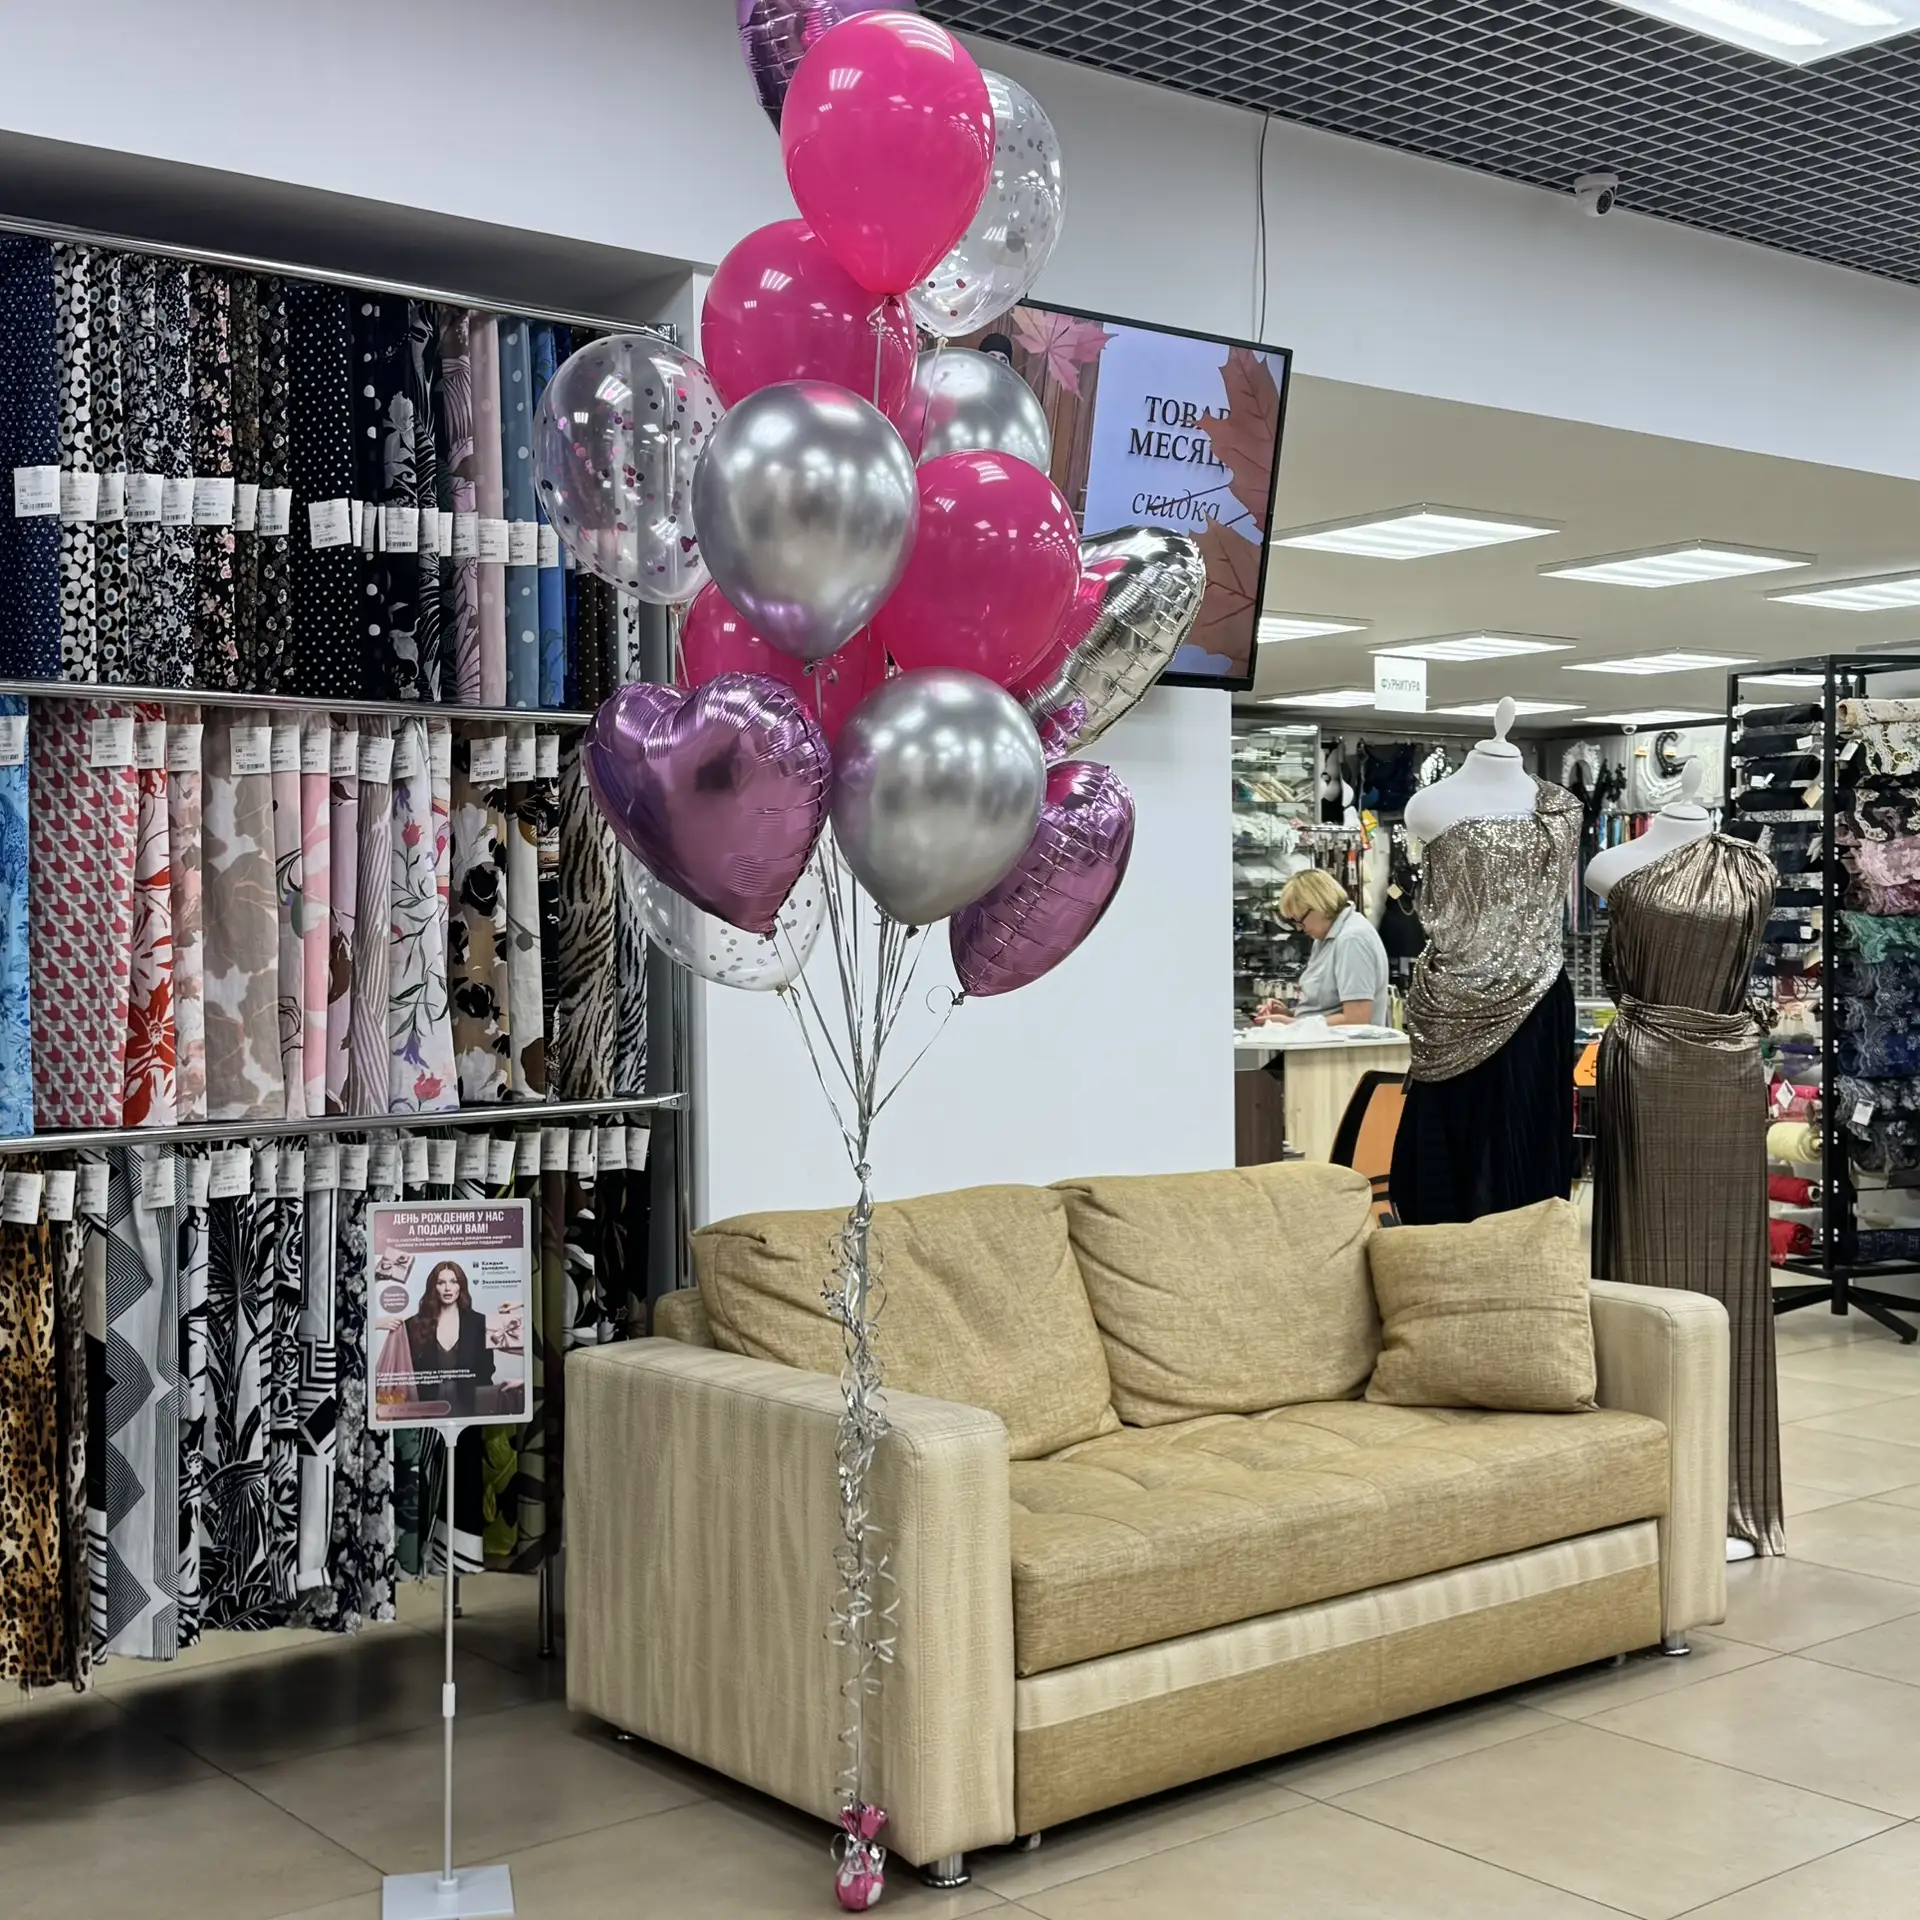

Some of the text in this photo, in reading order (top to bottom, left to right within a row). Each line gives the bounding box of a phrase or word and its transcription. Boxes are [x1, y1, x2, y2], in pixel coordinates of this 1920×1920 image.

[393, 1211, 504, 1225] ДЕНЬ РОЖДЕНИЯ У НАС
[408, 1223, 489, 1236] А ПОДАРКИ ВАМ!
